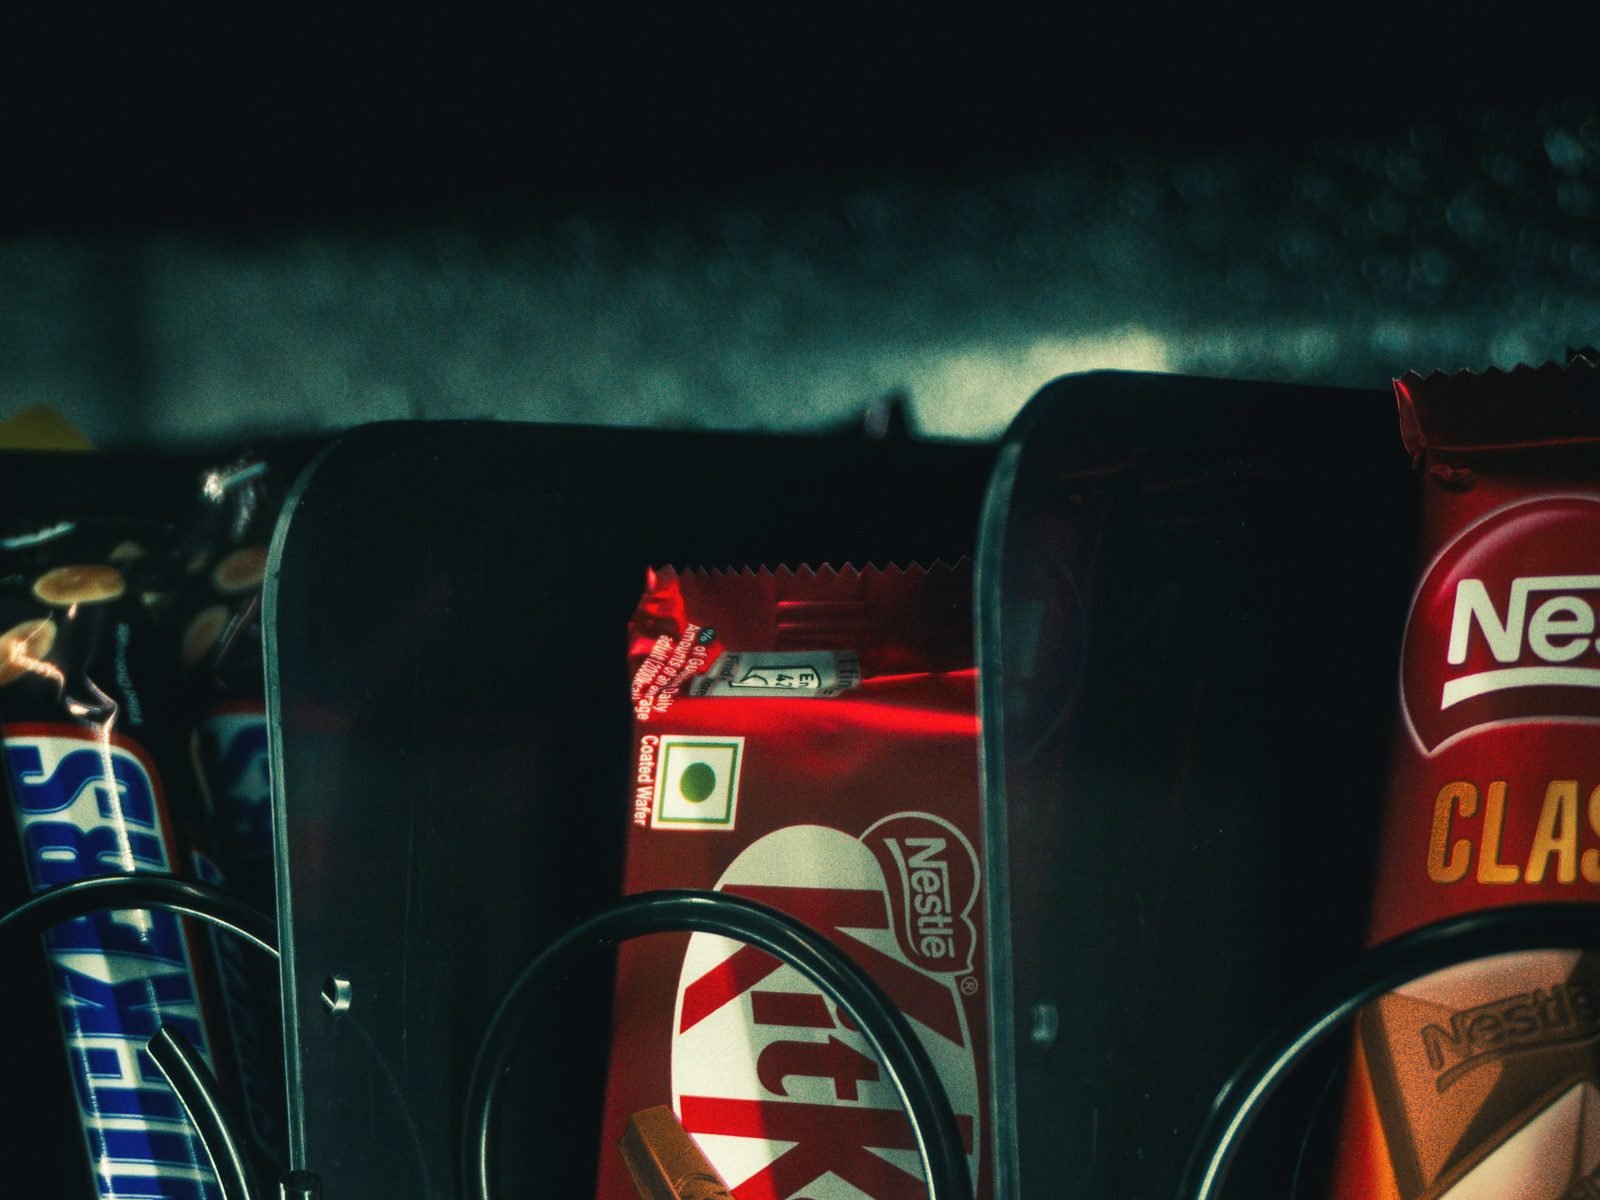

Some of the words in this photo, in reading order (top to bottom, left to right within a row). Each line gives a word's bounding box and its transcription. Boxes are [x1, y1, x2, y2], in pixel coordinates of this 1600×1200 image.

[1447, 574, 1600, 666] Ne
[667, 623, 701, 668] Amounts
[692, 645, 708, 657] of
[640, 734, 659, 785] Coated
[634, 786, 654, 827] Wafer
